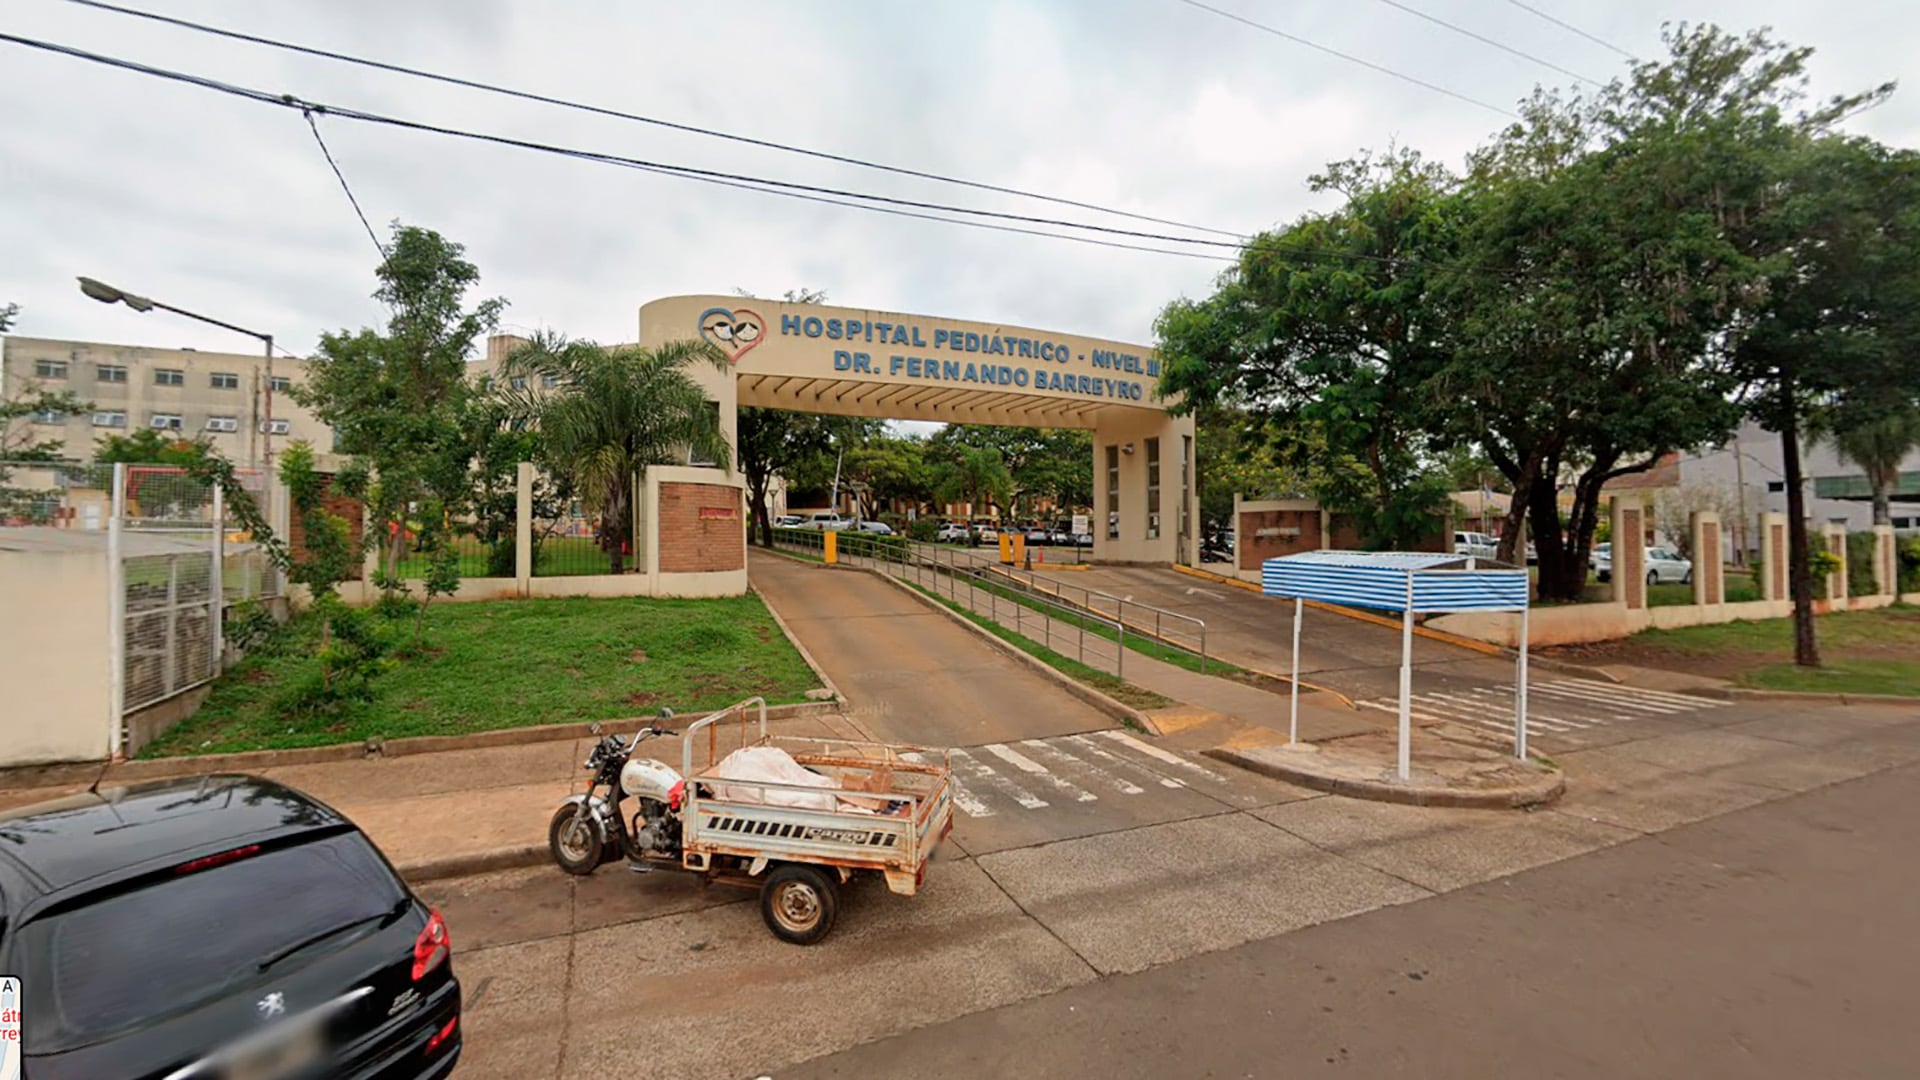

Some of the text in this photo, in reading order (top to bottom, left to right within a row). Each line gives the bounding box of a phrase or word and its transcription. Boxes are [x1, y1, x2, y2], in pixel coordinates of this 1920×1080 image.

[781, 314, 927, 347] HOSPITAL
[934, 328, 1070, 363] PEDIÁTRICO
[1092, 348, 1144, 374] NIVEL
[834, 350, 1143, 401] DR. FERNANDO BARREYRO
